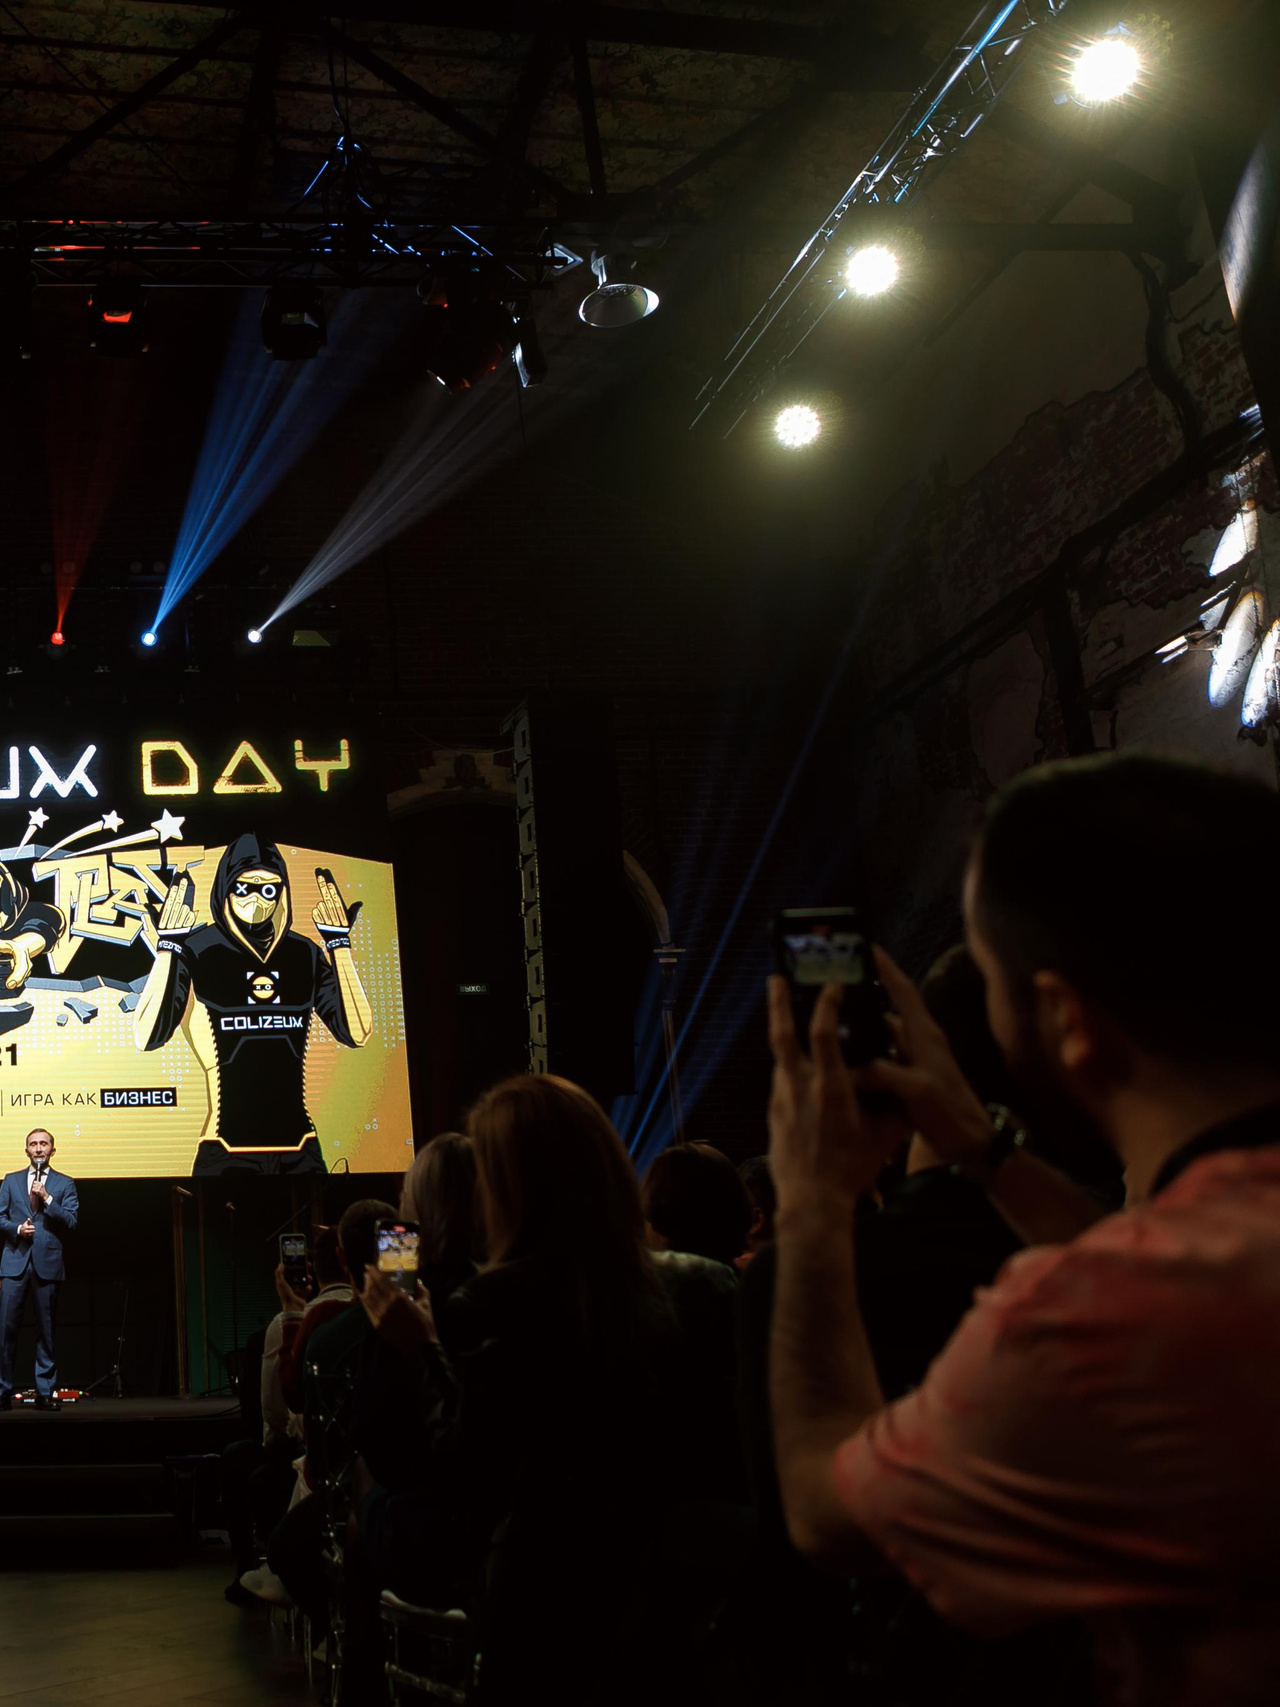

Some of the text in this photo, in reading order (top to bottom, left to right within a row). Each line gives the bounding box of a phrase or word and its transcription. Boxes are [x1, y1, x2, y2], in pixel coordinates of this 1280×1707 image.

[141, 738, 350, 796] DAY
[220, 1015, 303, 1031] COLIZEUM
[11, 1090, 174, 1107] ИГРА КАК БИЗНЕС
